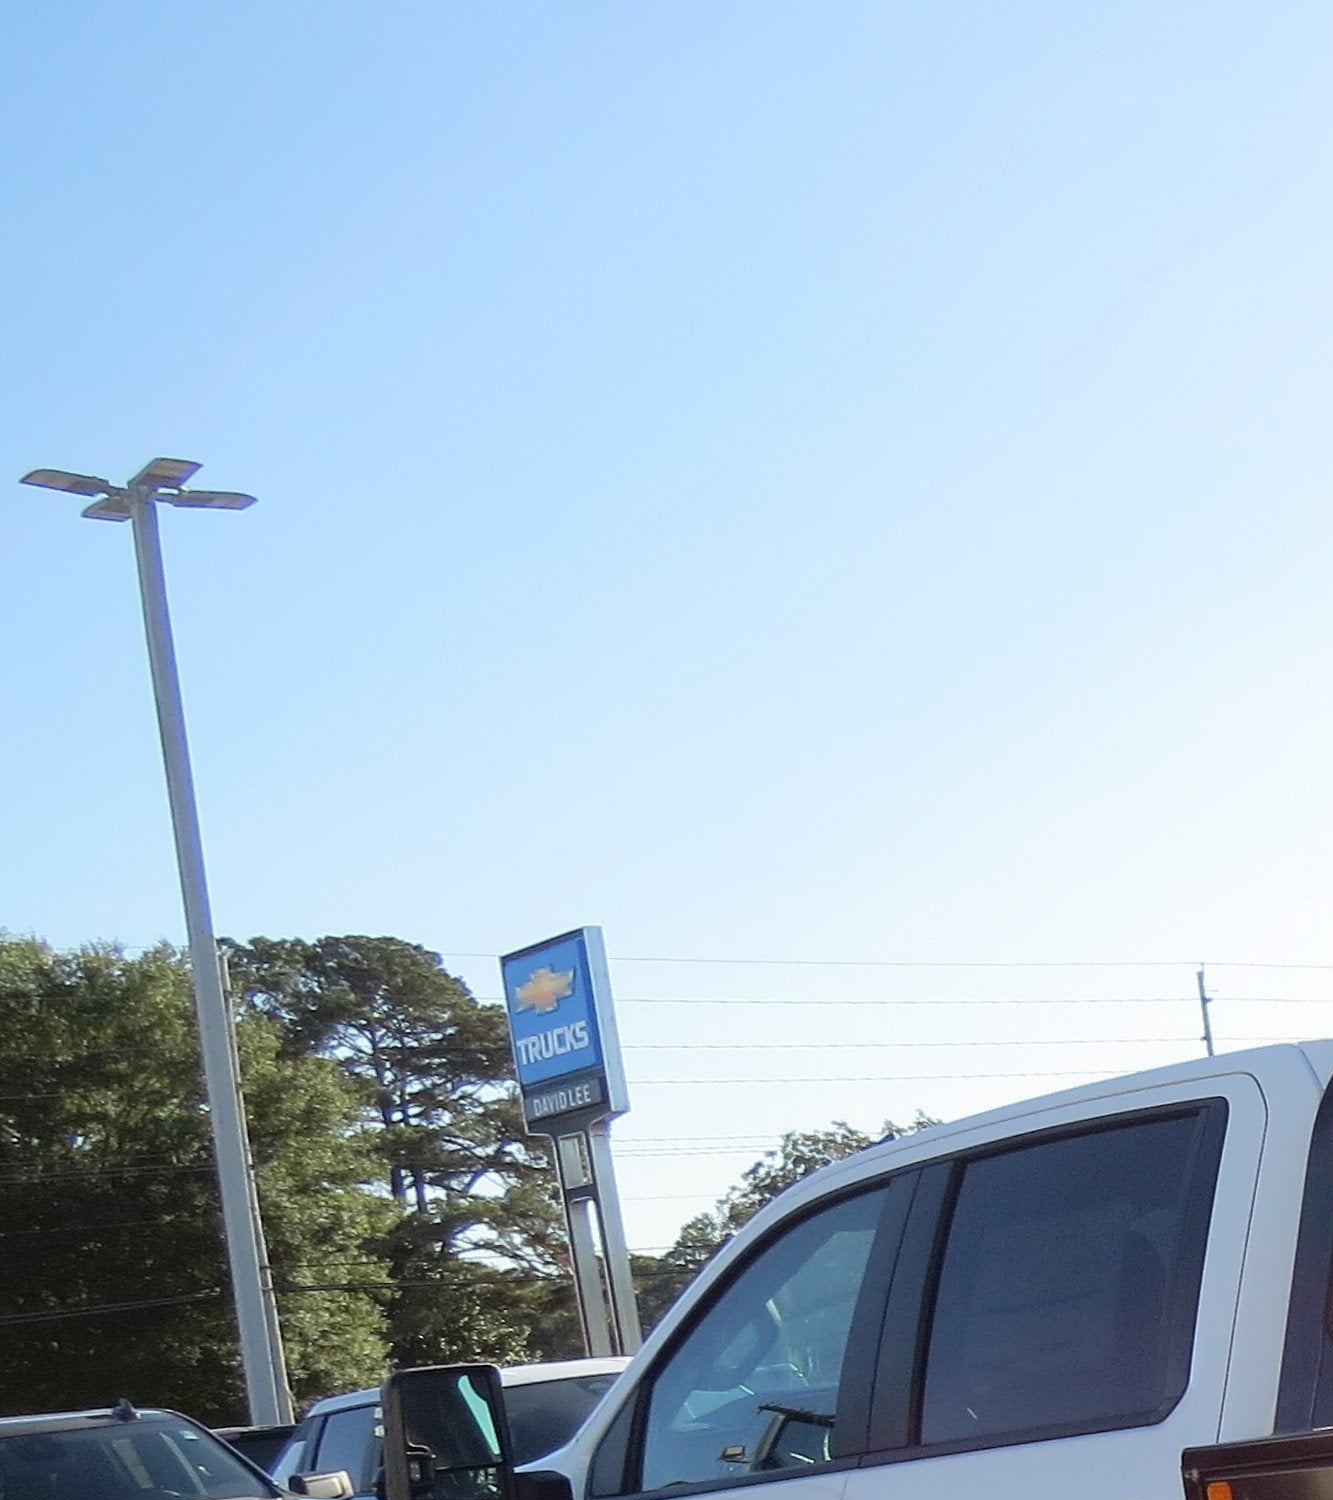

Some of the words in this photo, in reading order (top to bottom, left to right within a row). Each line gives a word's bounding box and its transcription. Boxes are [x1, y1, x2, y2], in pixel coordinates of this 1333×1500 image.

[516, 1020, 590, 1066] TRUCKS
[533, 1089, 569, 1117] DAVID
[569, 1085, 592, 1106] LEE
